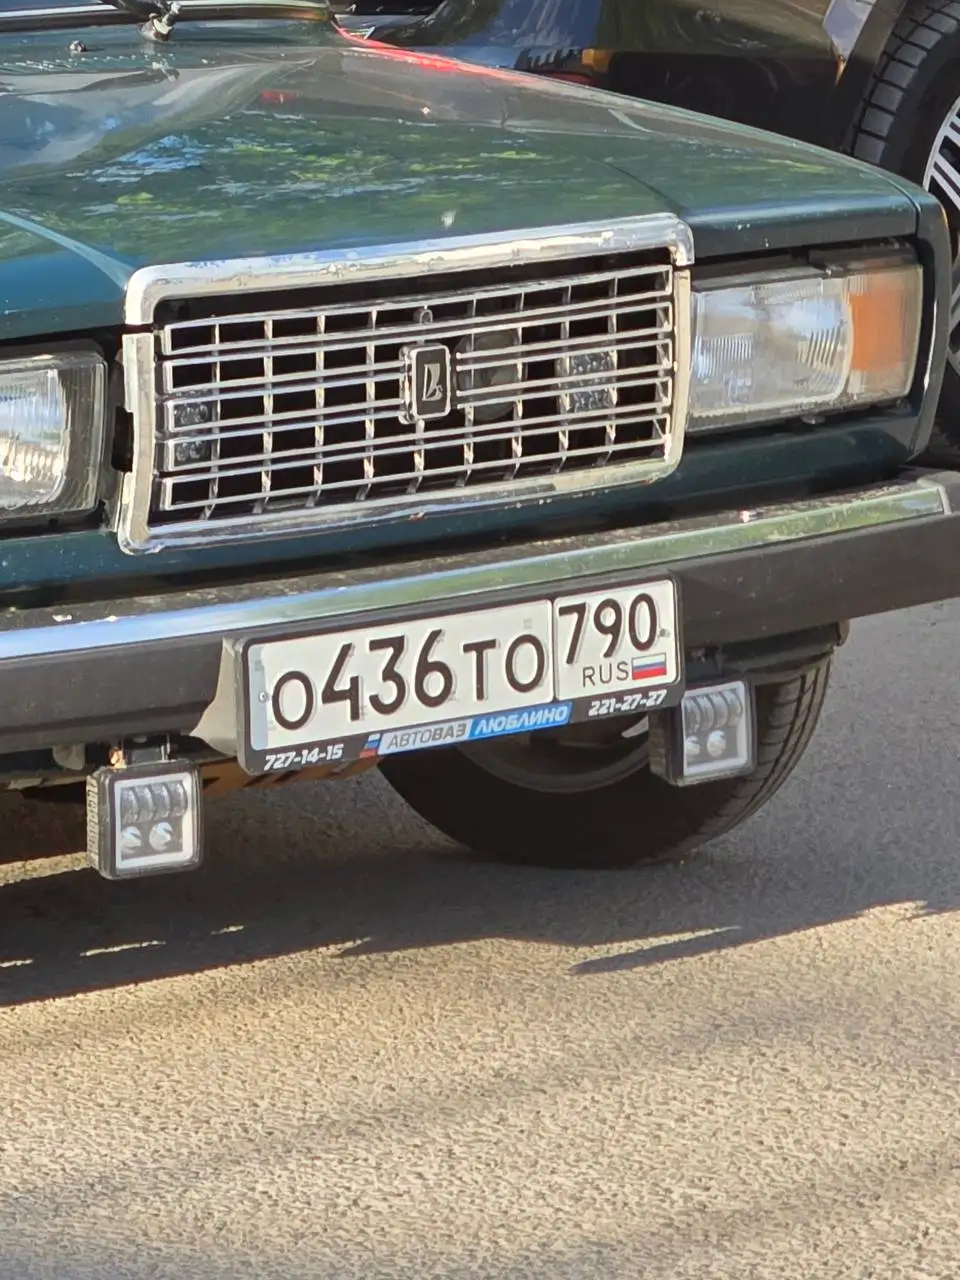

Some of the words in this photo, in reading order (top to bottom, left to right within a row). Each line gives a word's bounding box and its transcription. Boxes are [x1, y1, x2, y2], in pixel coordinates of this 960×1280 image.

[558, 592, 658, 666] 790
[582, 661, 629, 688] RUS
[588, 689, 668, 717] 221-27-27
[387, 723, 467, 750] АВТОВАЗ
[474, 704, 569, 736] ЛЮБЛИНО
[264, 744, 344, 771] 727-14-15
